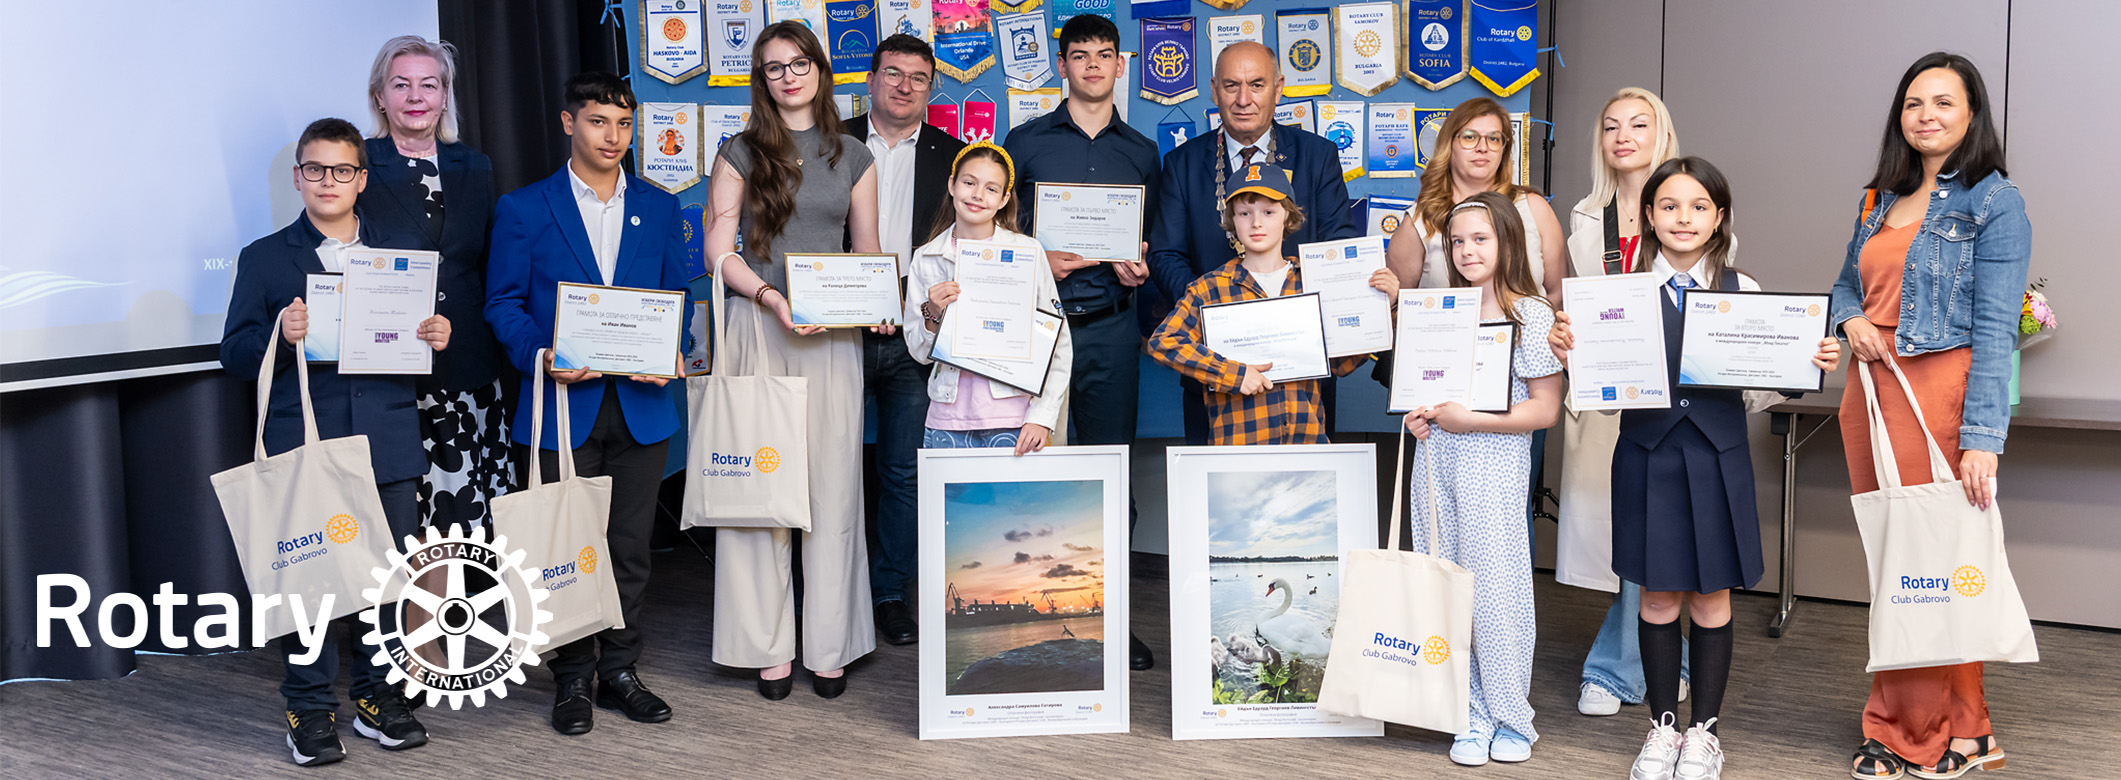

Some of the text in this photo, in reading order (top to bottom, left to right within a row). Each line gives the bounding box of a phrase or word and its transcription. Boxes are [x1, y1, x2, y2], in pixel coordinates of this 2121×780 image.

[717, 3, 739, 11] Rotary
[1074, 0, 1110, 9] GOOD
[1217, 25, 1240, 33] Rotary
[1490, 28, 1516, 37] Rotary
[1418, 58, 1451, 68] SOFIA
[652, 114, 674, 122] Rotary
[1420, 111, 1447, 126] РОТАРИ
[646, 164, 694, 173] КЮСТЕНДИЛ
[1245, 165, 1262, 182] A
[1044, 192, 1061, 200] Rotary
[961, 249, 981, 258] Rotary
[350, 258, 373, 267] Rotary
[315, 283, 336, 291] Rotary
[568, 293, 587, 302] Rotary
[1403, 299, 1423, 307] Rotary
[1695, 301, 1717, 311] Rotary
[1784, 305, 1807, 314] Rotary
[576, 309, 599, 317] ГРАМОТА
[605, 311, 630, 320] ОТЛИЧНО
[1599, 312, 1624, 321] YOUNG
[985, 320, 1005, 328] YOUNG
[1340, 316, 1360, 325] YOUNG
[377, 332, 399, 340] YOUNG
[1740, 332, 1776, 340] Красимирова
[1424, 370, 1445, 378] YOUNG
[1640, 388, 1663, 396] Rotary
[711, 452, 752, 468] Rotary
[702, 468, 751, 478] Club Gabrovo
[276, 530, 323, 555] Rotary
[271, 547, 328, 571] Club Gabrovo
[542, 560, 576, 582] Rotary
[549, 576, 578, 592] Gabrovo
[1900, 575, 1950, 592] Rotary
[1891, 594, 1951, 604] Club Gabrovo
[1373, 632, 1421, 656] Rotary
[1362, 648, 1417, 667] Club Gabrovo
